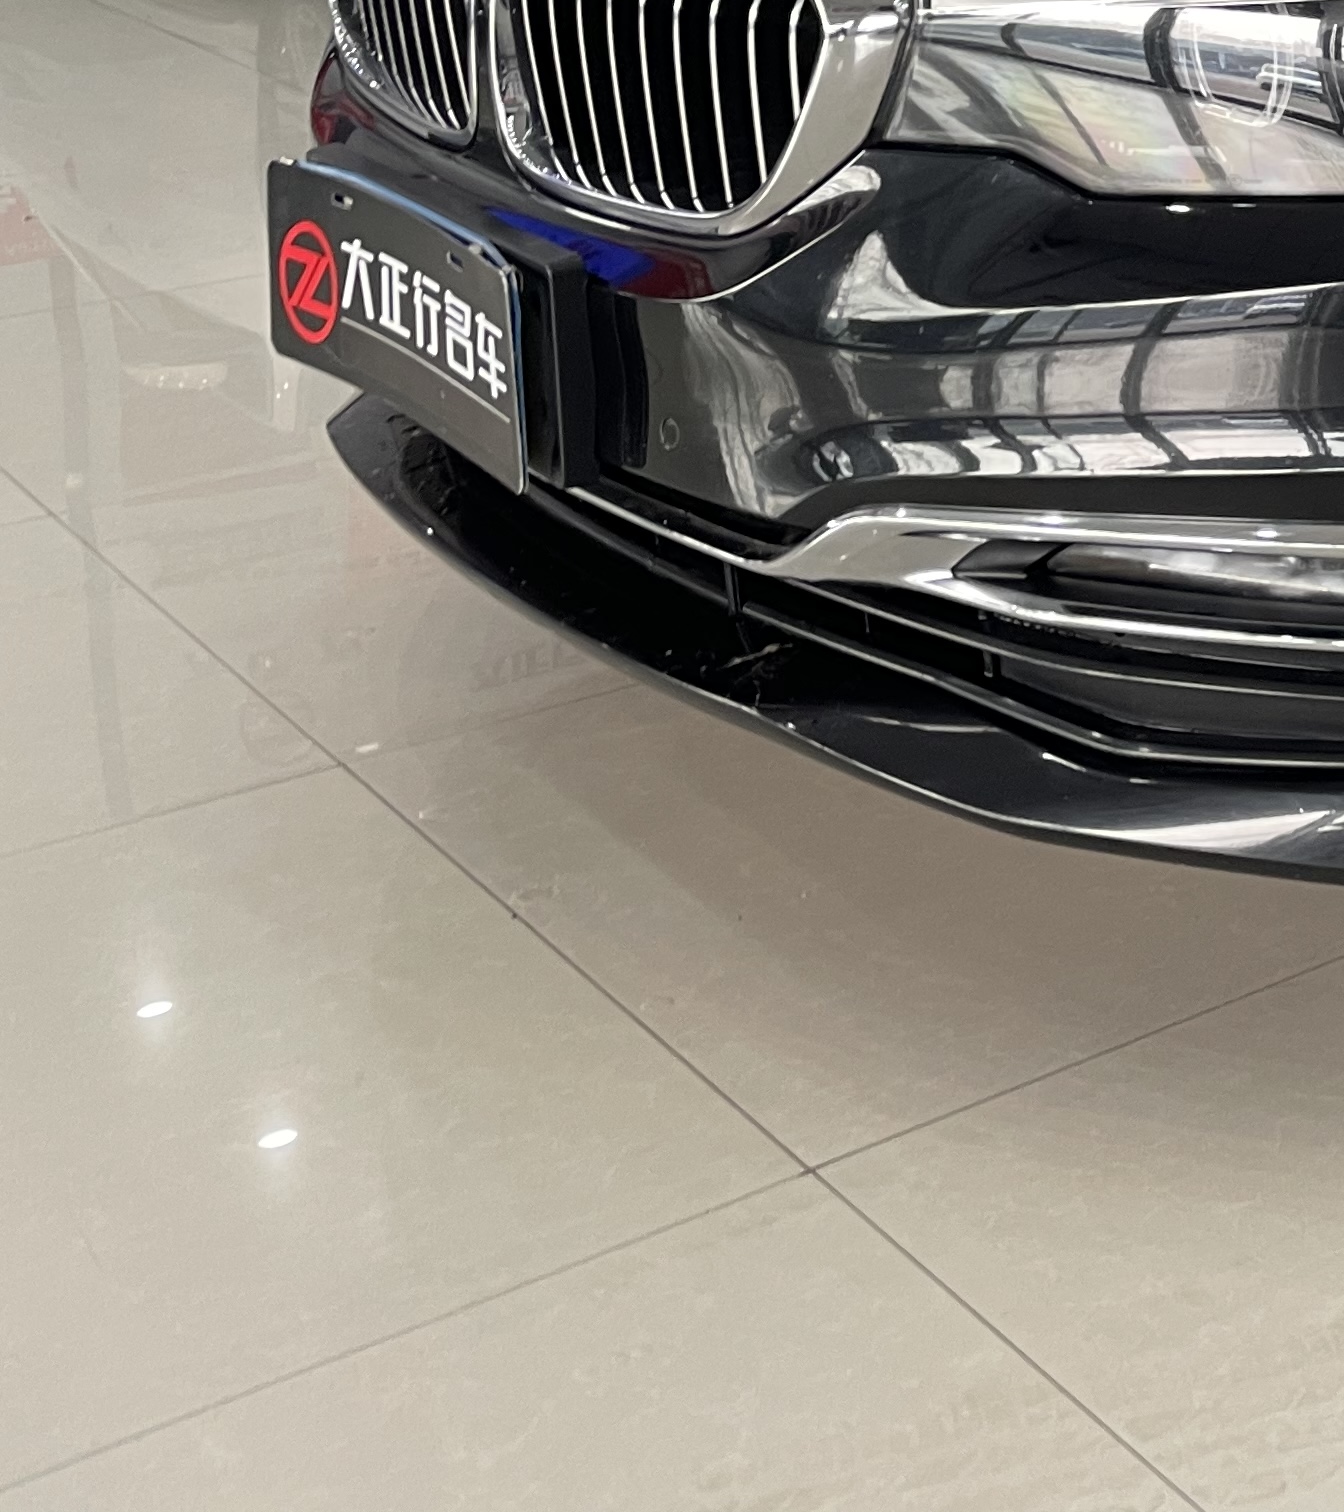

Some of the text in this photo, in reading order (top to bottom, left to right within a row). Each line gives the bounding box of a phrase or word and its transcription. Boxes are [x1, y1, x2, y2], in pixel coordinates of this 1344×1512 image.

[340, 238, 508, 399] 大正行名车
